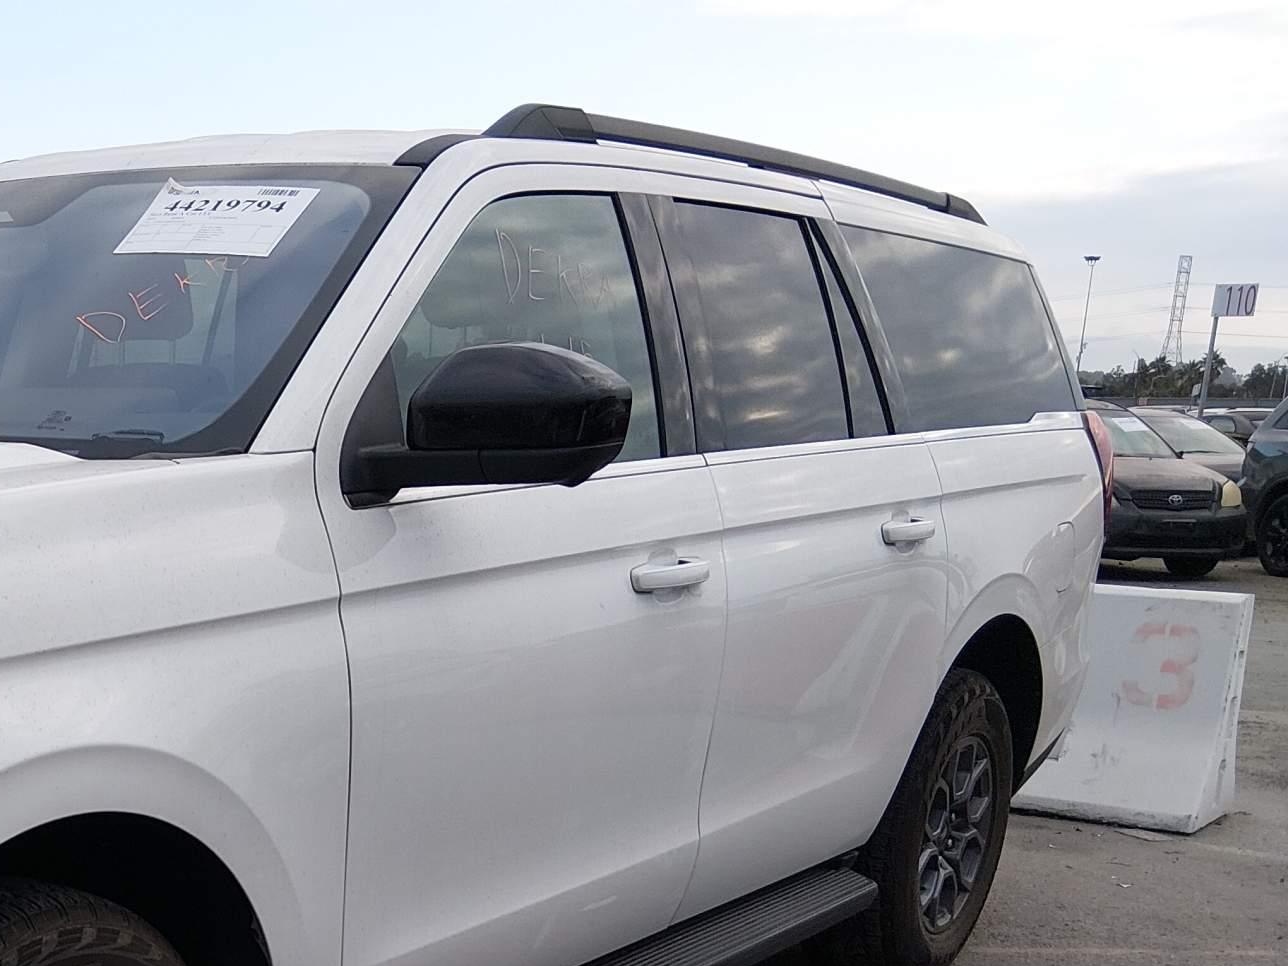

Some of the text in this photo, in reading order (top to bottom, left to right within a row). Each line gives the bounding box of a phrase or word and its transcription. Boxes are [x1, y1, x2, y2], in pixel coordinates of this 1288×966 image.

[163, 199, 288, 214] 44219794
[1225, 284, 1258, 316] 110
[1122, 622, 1199, 710] 3
